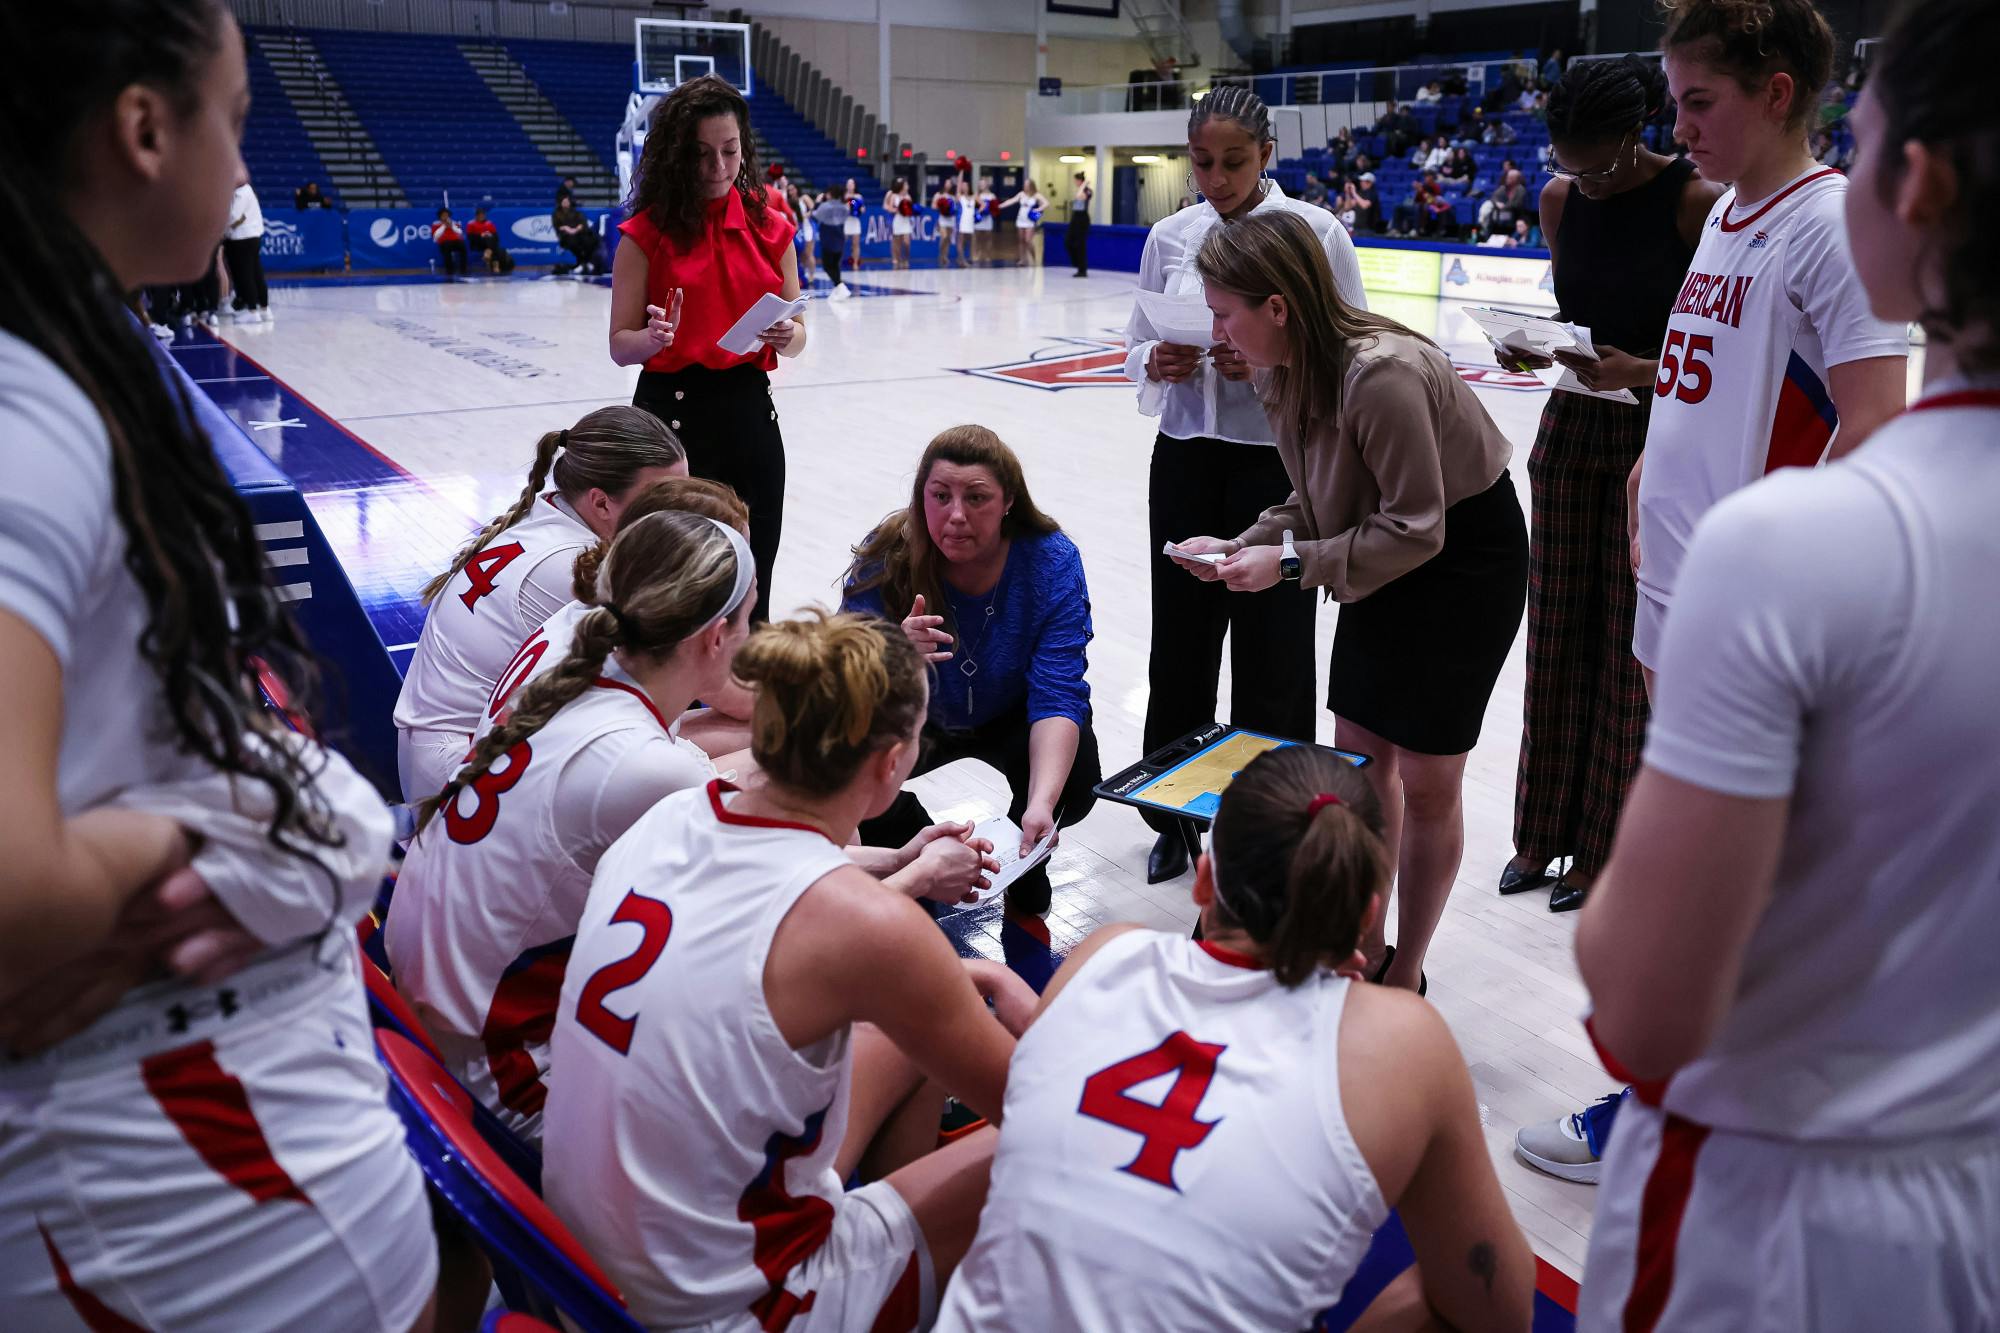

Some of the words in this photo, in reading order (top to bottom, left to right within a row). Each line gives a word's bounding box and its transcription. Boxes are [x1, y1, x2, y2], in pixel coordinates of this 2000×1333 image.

[1655, 328, 1714, 405] 55
[458, 541, 526, 614] 4
[440, 738, 533, 845] 8
[576, 888, 673, 1056] 2
[1078, 1030, 1228, 1195] 4
